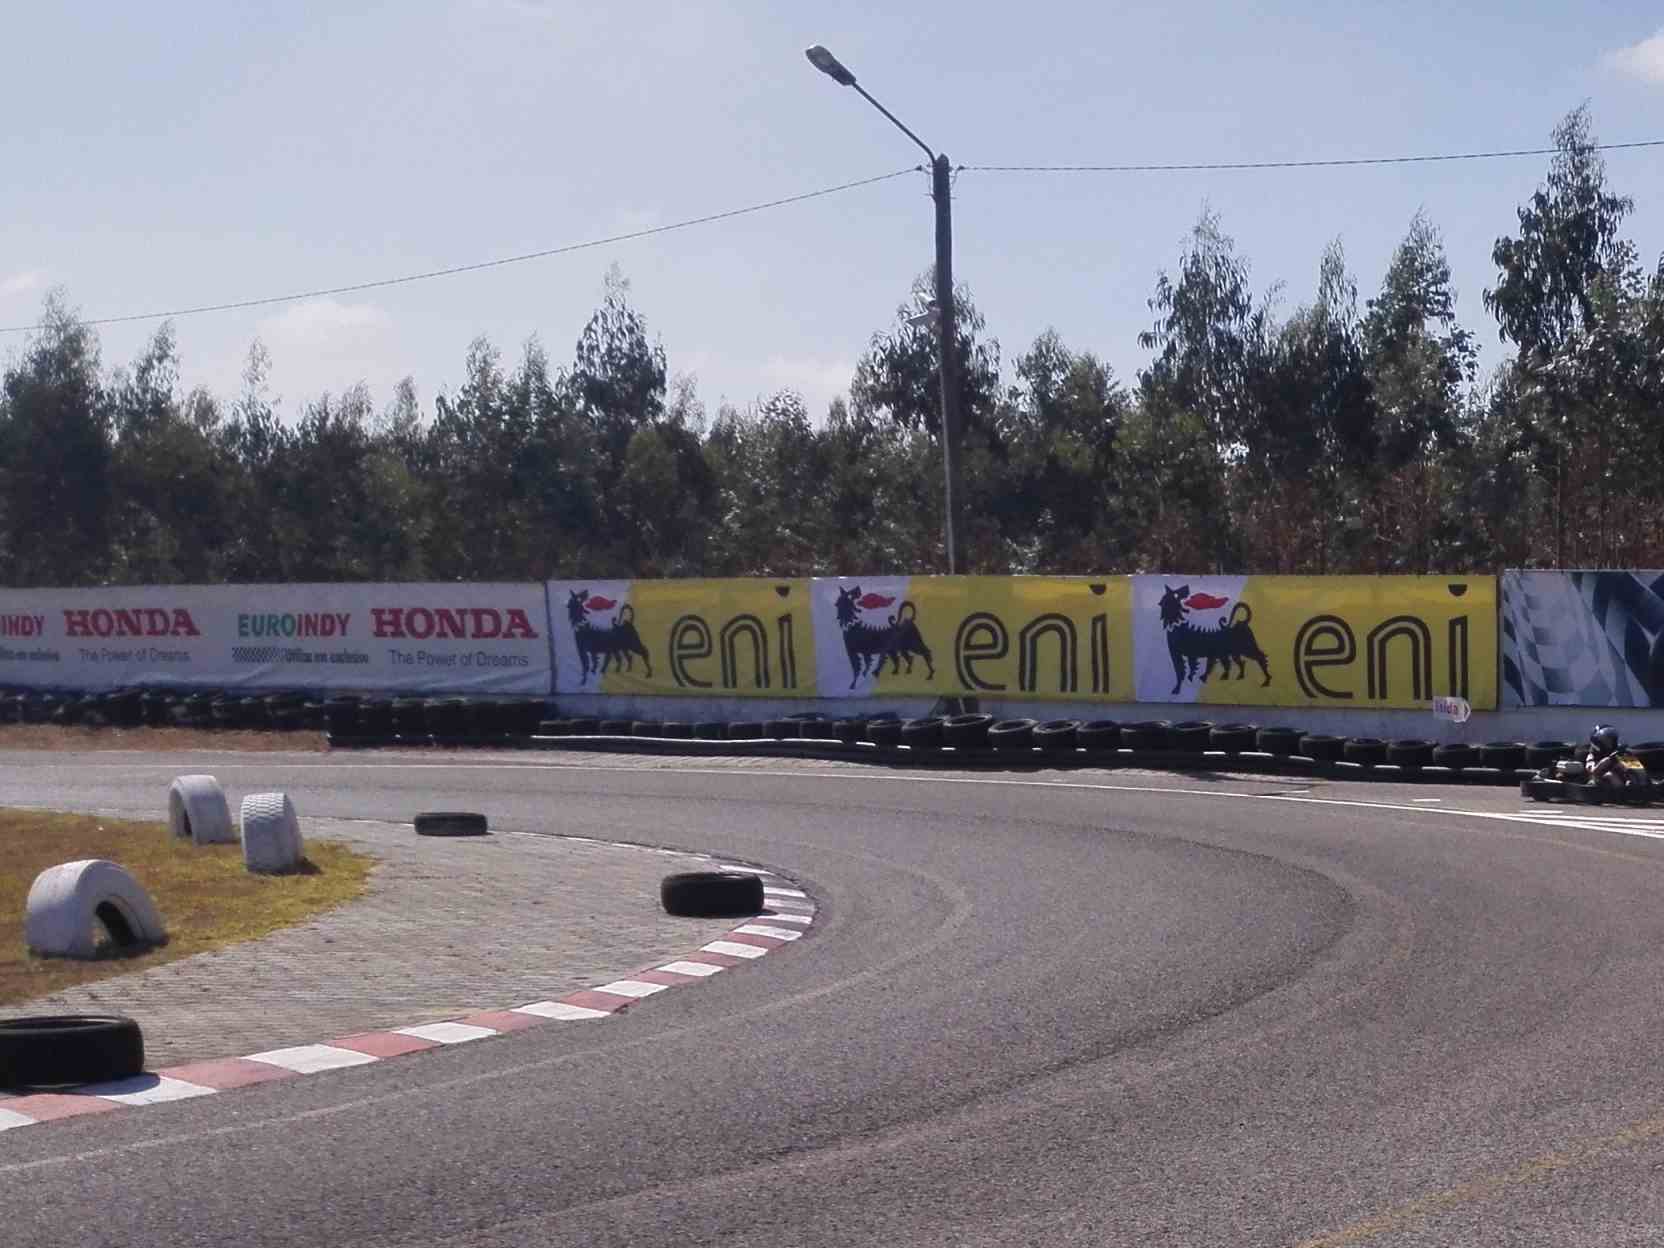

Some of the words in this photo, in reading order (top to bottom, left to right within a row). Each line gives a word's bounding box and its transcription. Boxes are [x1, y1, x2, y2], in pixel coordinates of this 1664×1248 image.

[64, 608, 201, 637] HONDA
[238, 613, 351, 638] EUROINDY
[371, 608, 539, 640] HONDA
[669, 586, 798, 689] eni
[955, 584, 1109, 694] eni
[1294, 584, 1469, 700] eni
[388, 649, 413, 665] The
[417, 650, 457, 667] Power
[460, 651, 473, 667] of
[476, 651, 529, 667] Dreams
